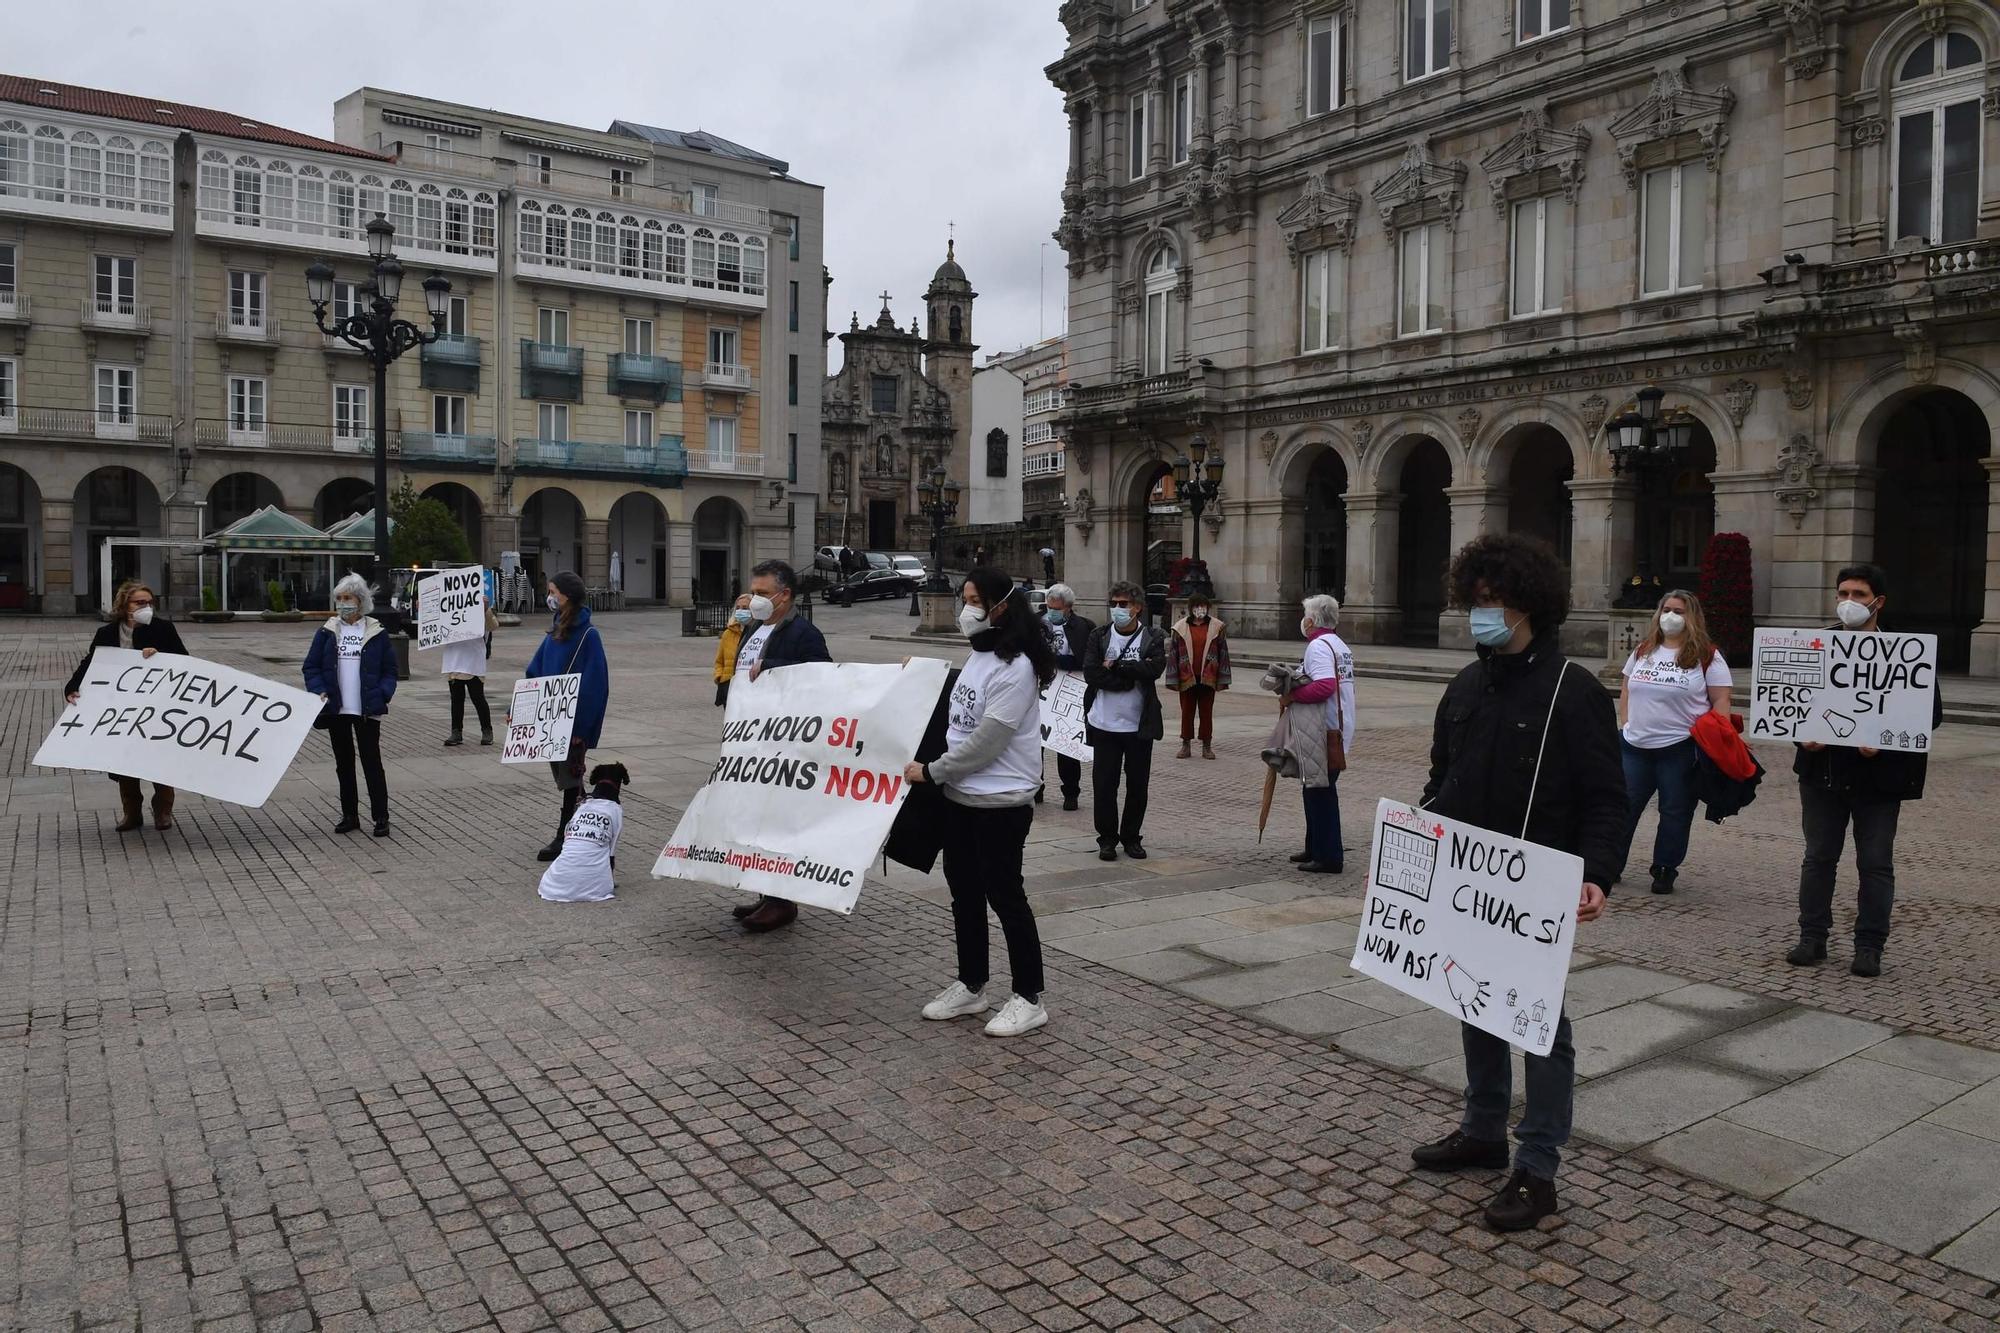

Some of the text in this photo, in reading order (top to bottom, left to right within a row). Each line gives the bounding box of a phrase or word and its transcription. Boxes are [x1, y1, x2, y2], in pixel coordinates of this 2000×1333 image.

[1288, 402, 1372, 420] CONSISTORIALES
[1378, 399, 1391, 410] DE
[1398, 398, 1411, 408] LA
[1417, 393, 1440, 407] MVY
[1447, 388, 1486, 401] NOBLE
[1493, 384, 1500, 396] Y
[1507, 381, 1535, 394] MVY
[1541, 377, 1572, 391] LEAL
[1581, 369, 1634, 386] CIVDAD
[1645, 368, 1664, 379] DE
[1673, 364, 1690, 376] LA
[444, 571, 481, 592] NOVO
[440, 590, 481, 612] CHUAC
[419, 636, 431, 648] NON
[421, 624, 438, 636] PERO
[1760, 634, 1925, 663] HOSPITAL NOVO
[1636, 669, 1659, 677] PERO
[1830, 662, 1932, 690] CHUAC
[116, 666, 292, 723] CEMENTO
[544, 676, 579, 698] NOVO
[537, 696, 578, 722] CHUAC
[1768, 705, 1812, 719] NON
[90, 706, 261, 763] PERSOAL
[511, 726, 536, 741] PERO
[757, 716, 823, 743] NOVO
[827, 716, 865, 758] SI,
[504, 742, 529, 759] NON
[824, 765, 903, 805] NON
[576, 819, 602, 828] CHUAC
[579, 813, 610, 826] NOVO
[1386, 808, 1435, 836] HOSPITAL
[1368, 896, 1426, 936] PERO
[1452, 884, 1530, 938] CHUAC
[1363, 933, 1401, 964] NON
